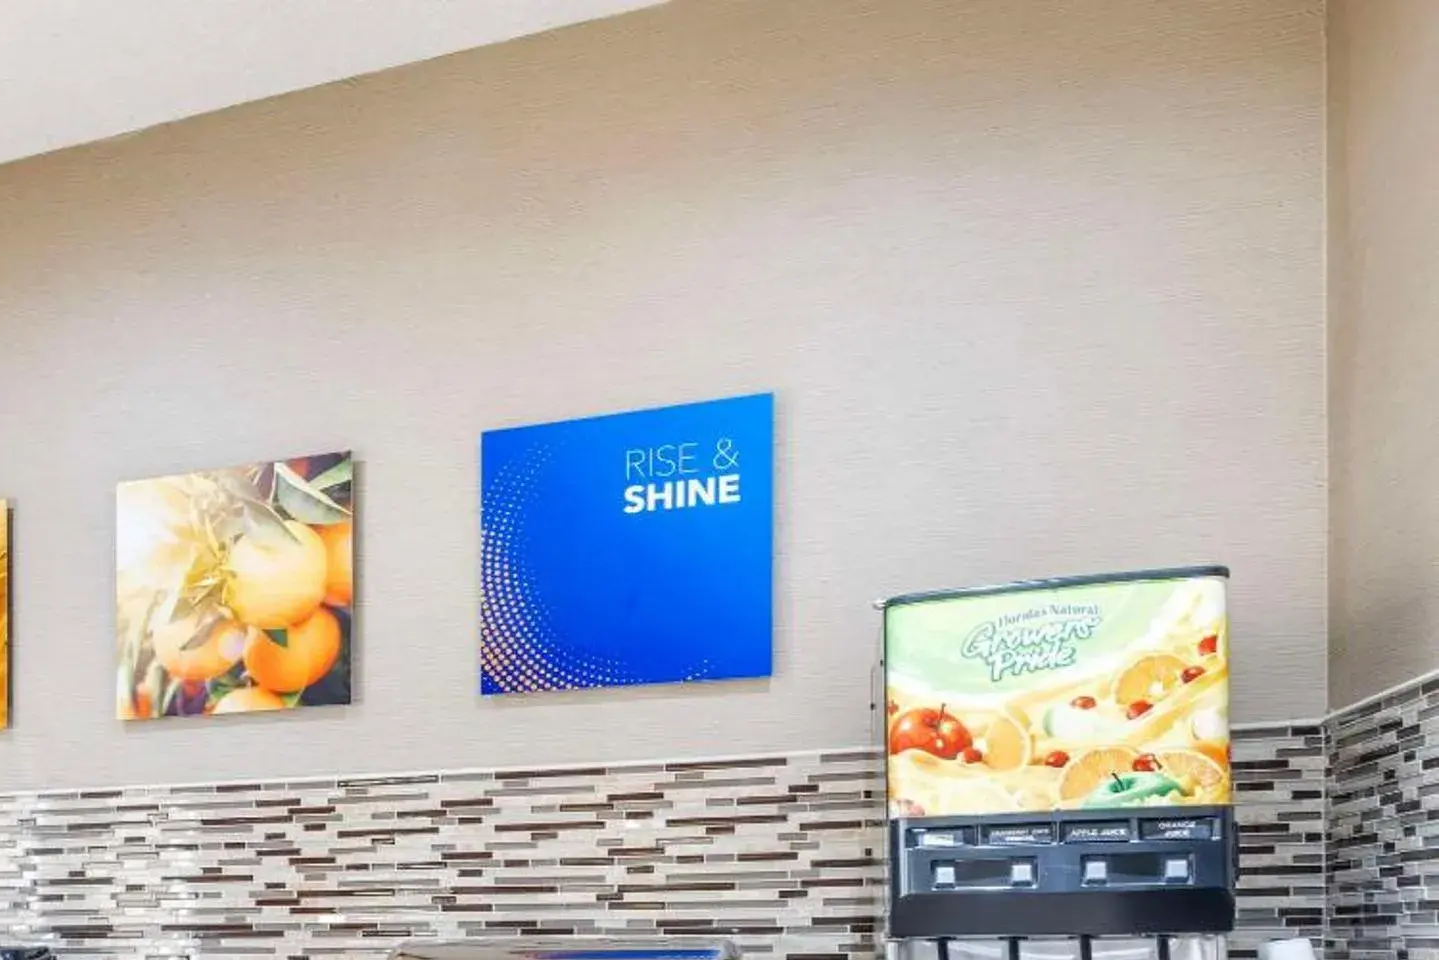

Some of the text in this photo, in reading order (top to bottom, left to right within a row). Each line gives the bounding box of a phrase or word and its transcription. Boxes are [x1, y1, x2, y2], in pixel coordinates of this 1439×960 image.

[625, 438, 740, 480] RISE &
[623, 473, 741, 514] SHINE
